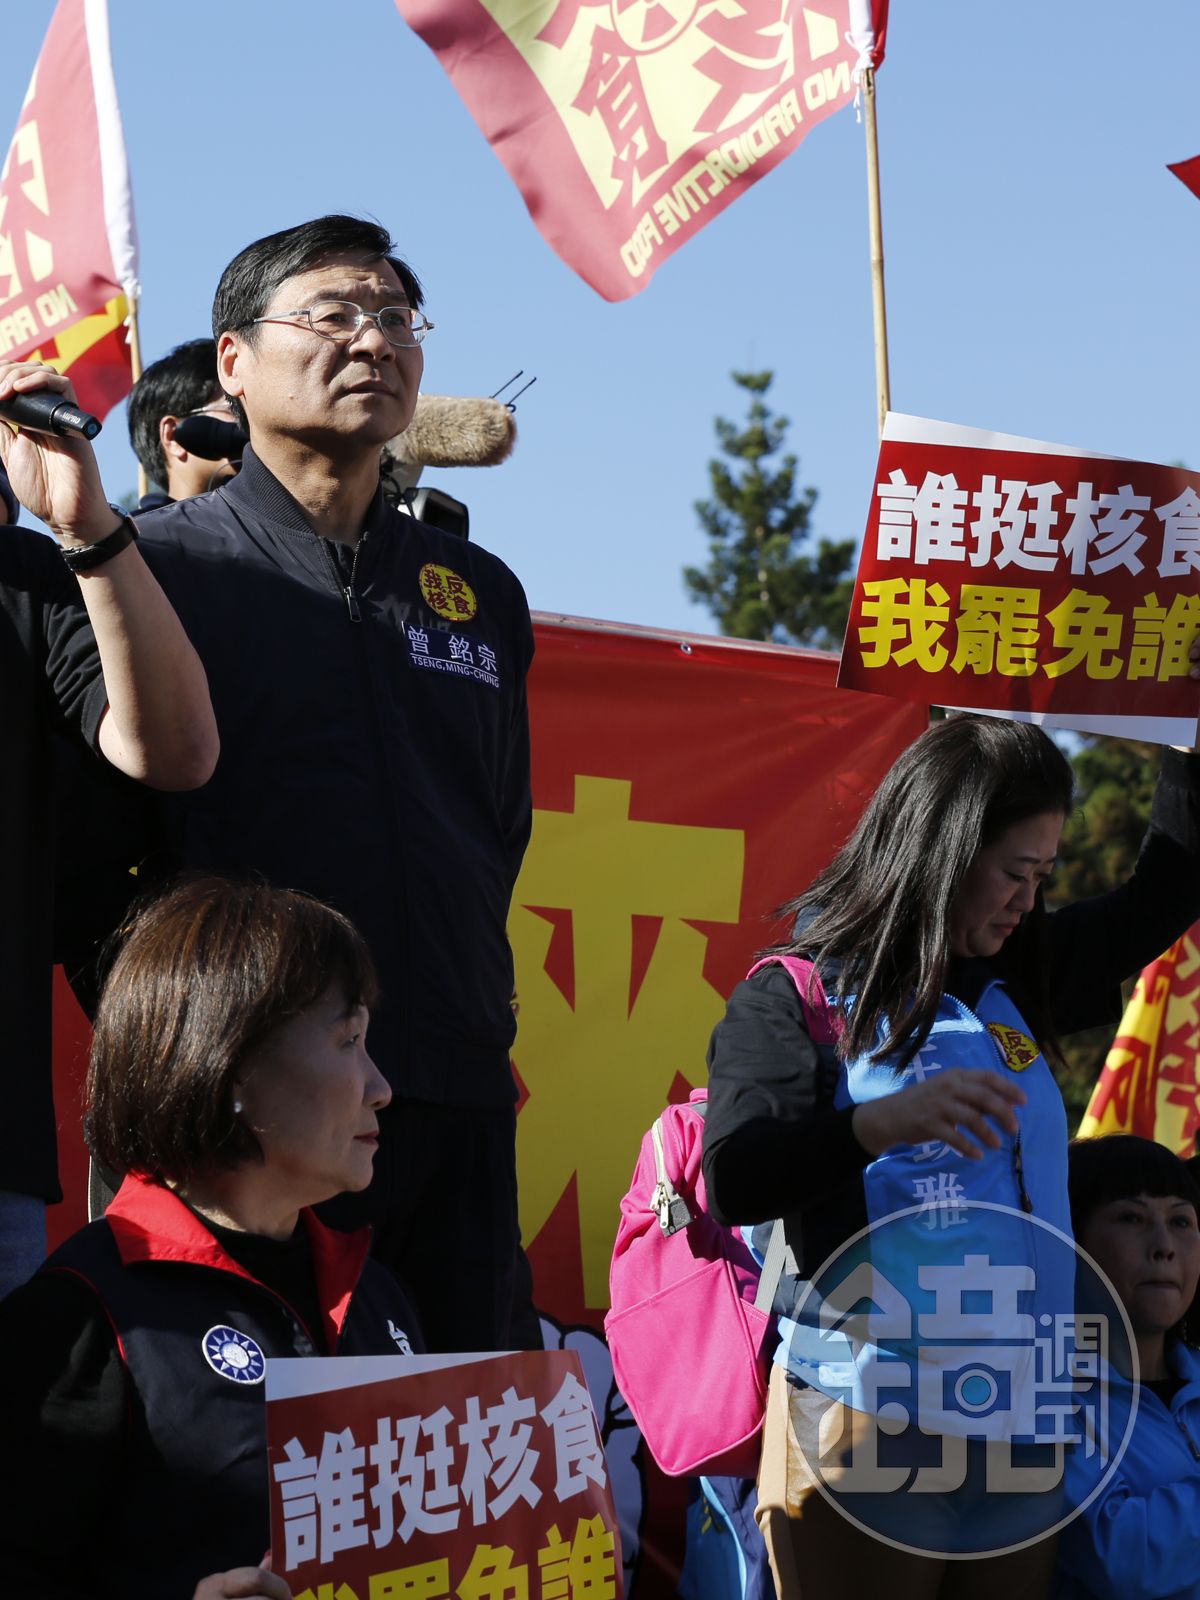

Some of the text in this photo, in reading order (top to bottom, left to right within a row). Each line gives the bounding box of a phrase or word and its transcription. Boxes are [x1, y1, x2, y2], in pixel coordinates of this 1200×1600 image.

[876, 468, 1200, 578] 誰挺核食
[407, 625, 498, 673] 曾銘宗
[858, 577, 1200, 682] 我罷免誰
[273, 1371, 607, 1572] 誰挺核食
